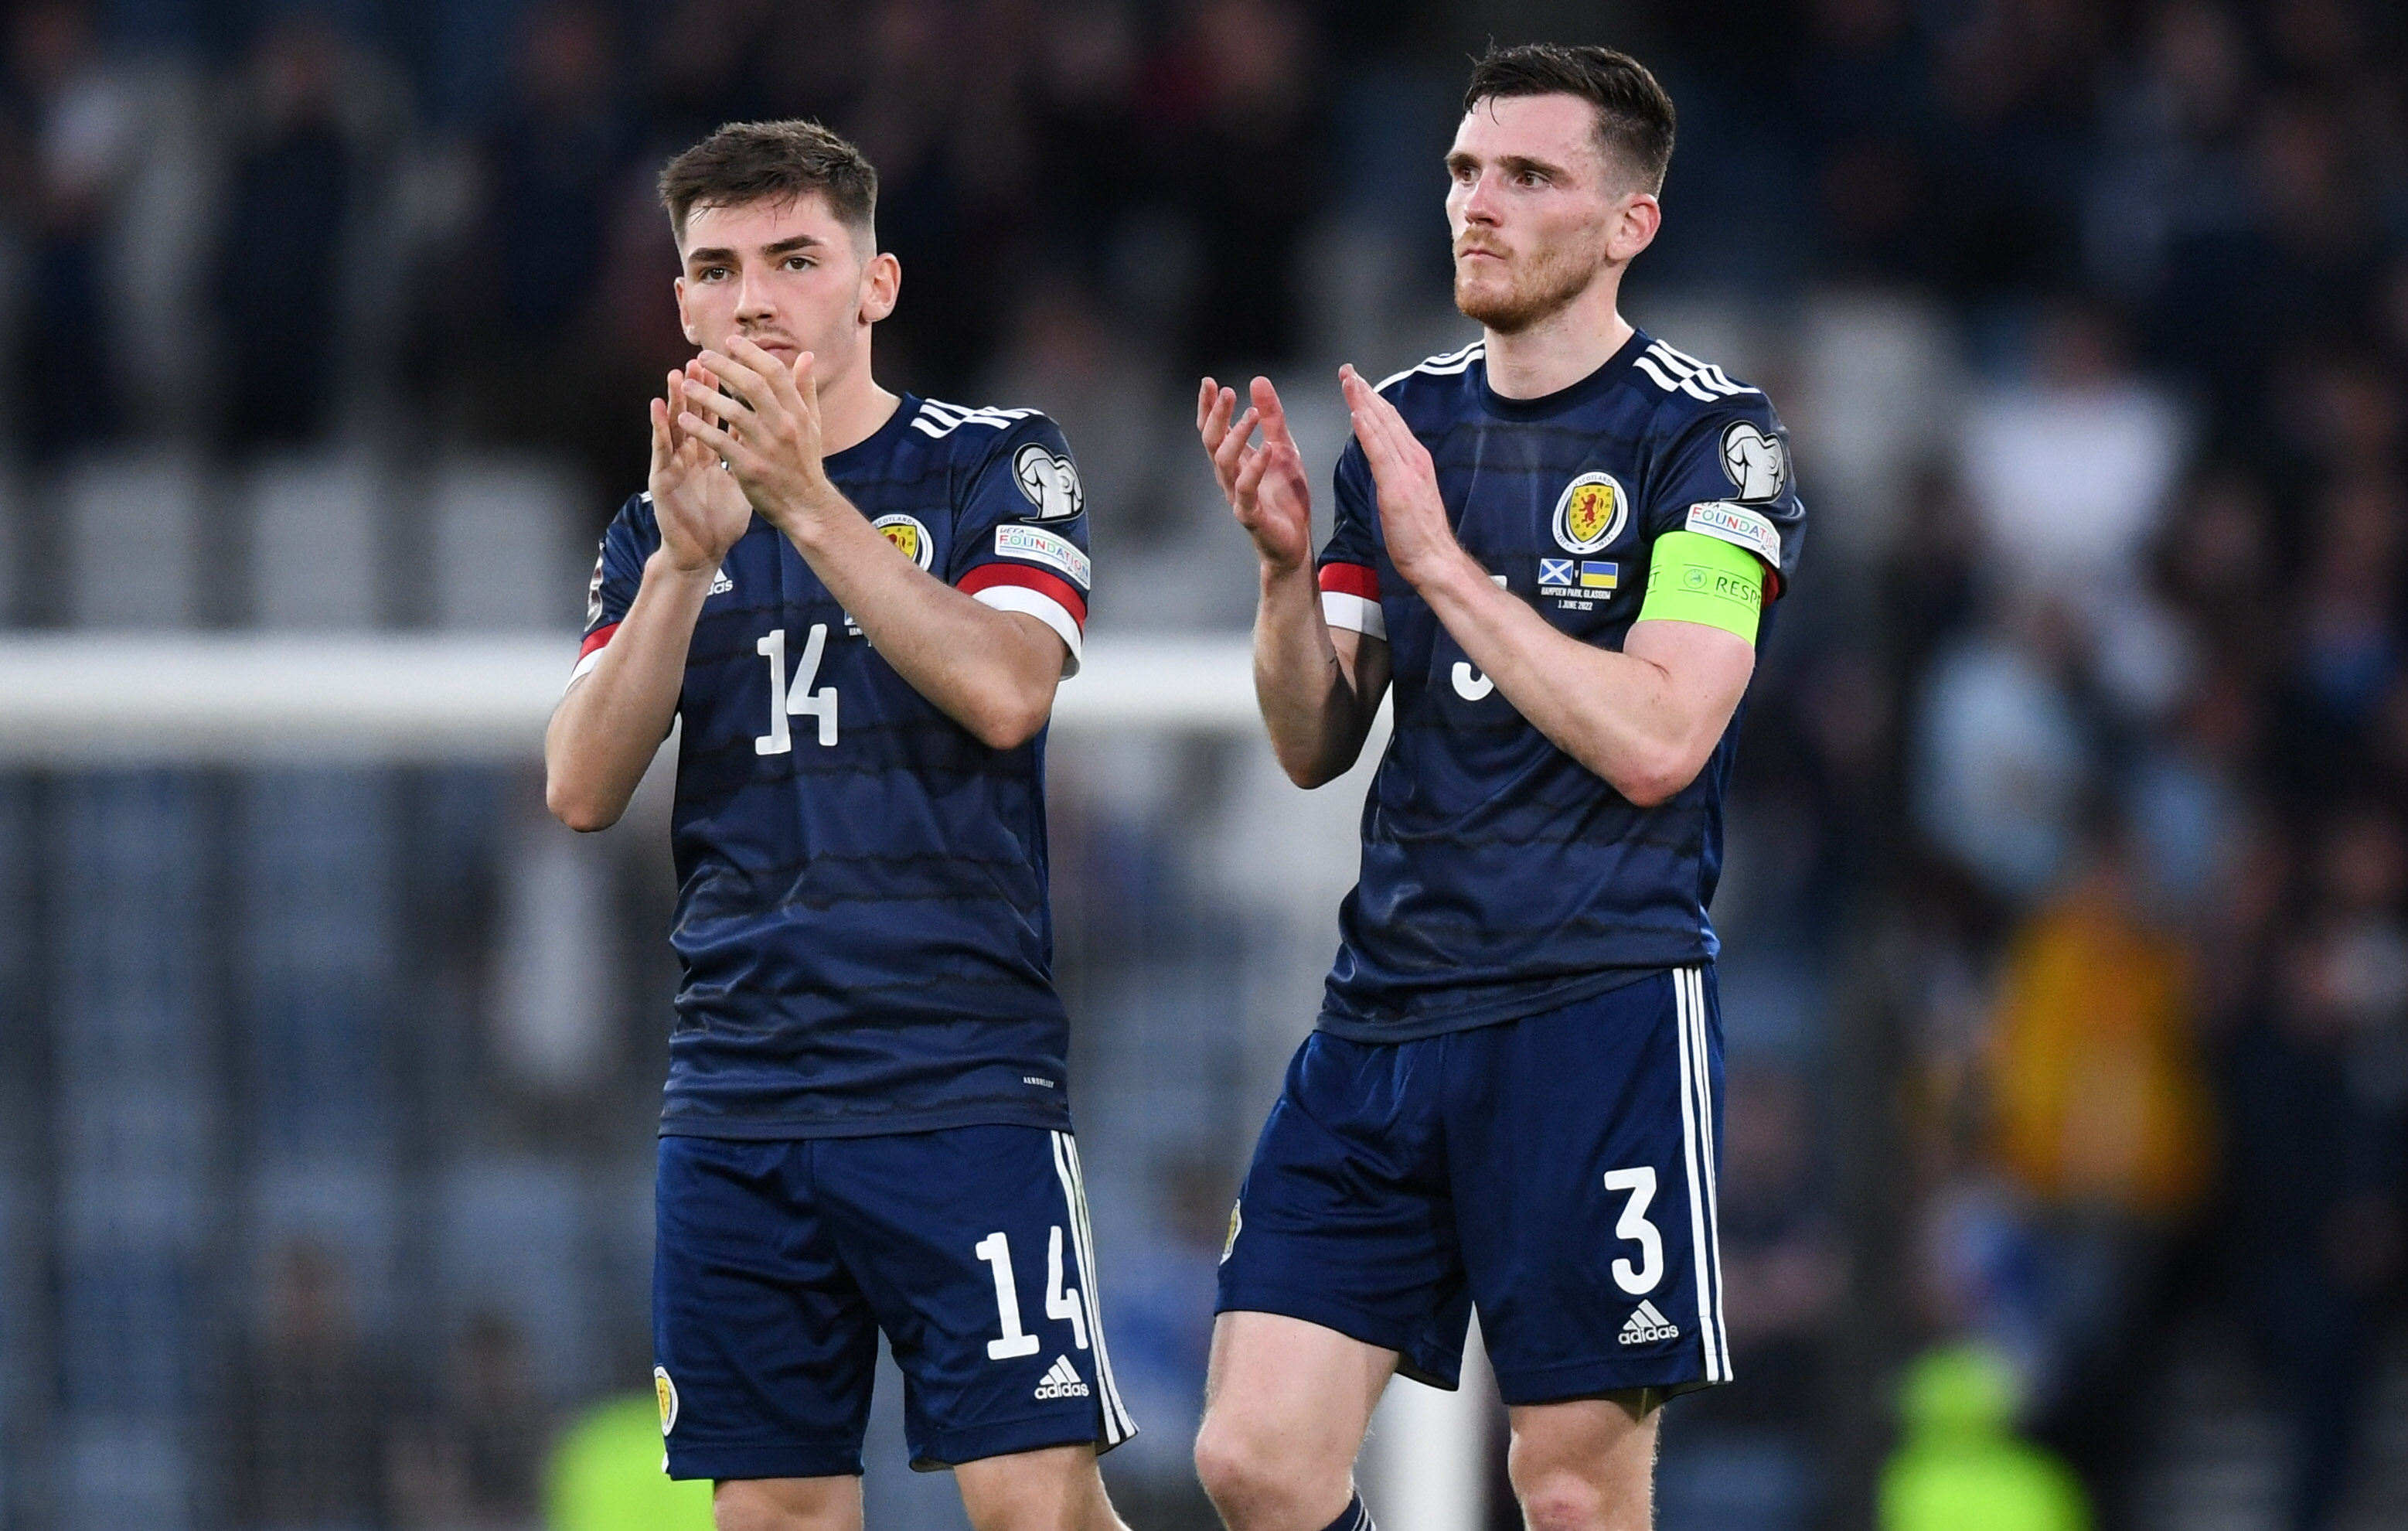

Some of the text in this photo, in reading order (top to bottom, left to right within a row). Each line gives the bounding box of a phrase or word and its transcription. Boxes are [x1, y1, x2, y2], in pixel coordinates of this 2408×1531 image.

[1000, 534, 1088, 578] FOUNDATION
[755, 623, 838, 755] 14
[1604, 1166, 1664, 1295] 3
[976, 1226, 1088, 1360] 14
[1618, 1325, 1679, 1345] adidas
[1034, 1383, 1089, 1400] adidas
